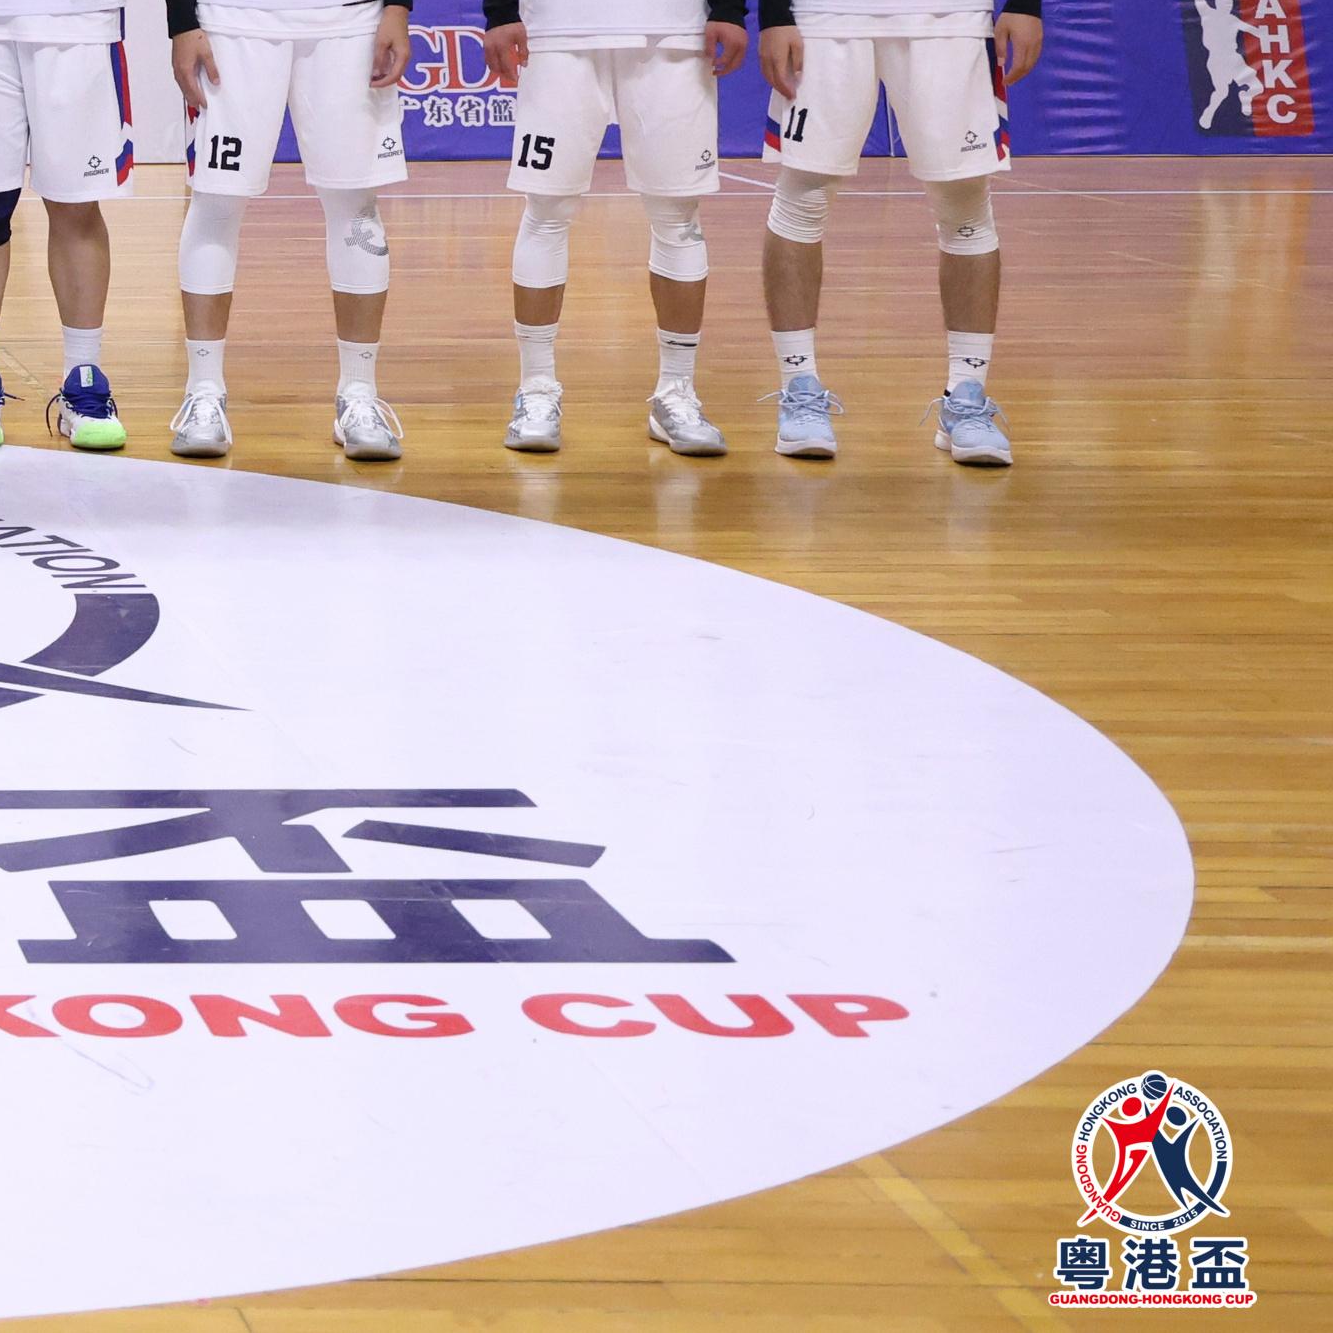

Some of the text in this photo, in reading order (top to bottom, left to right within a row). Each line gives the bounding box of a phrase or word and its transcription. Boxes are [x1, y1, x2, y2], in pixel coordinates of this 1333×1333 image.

[784, 106, 808, 142] 11
[208, 135, 242, 171] 12
[518, 134, 555, 170] 15
[520, 991, 910, 1040] CUP
